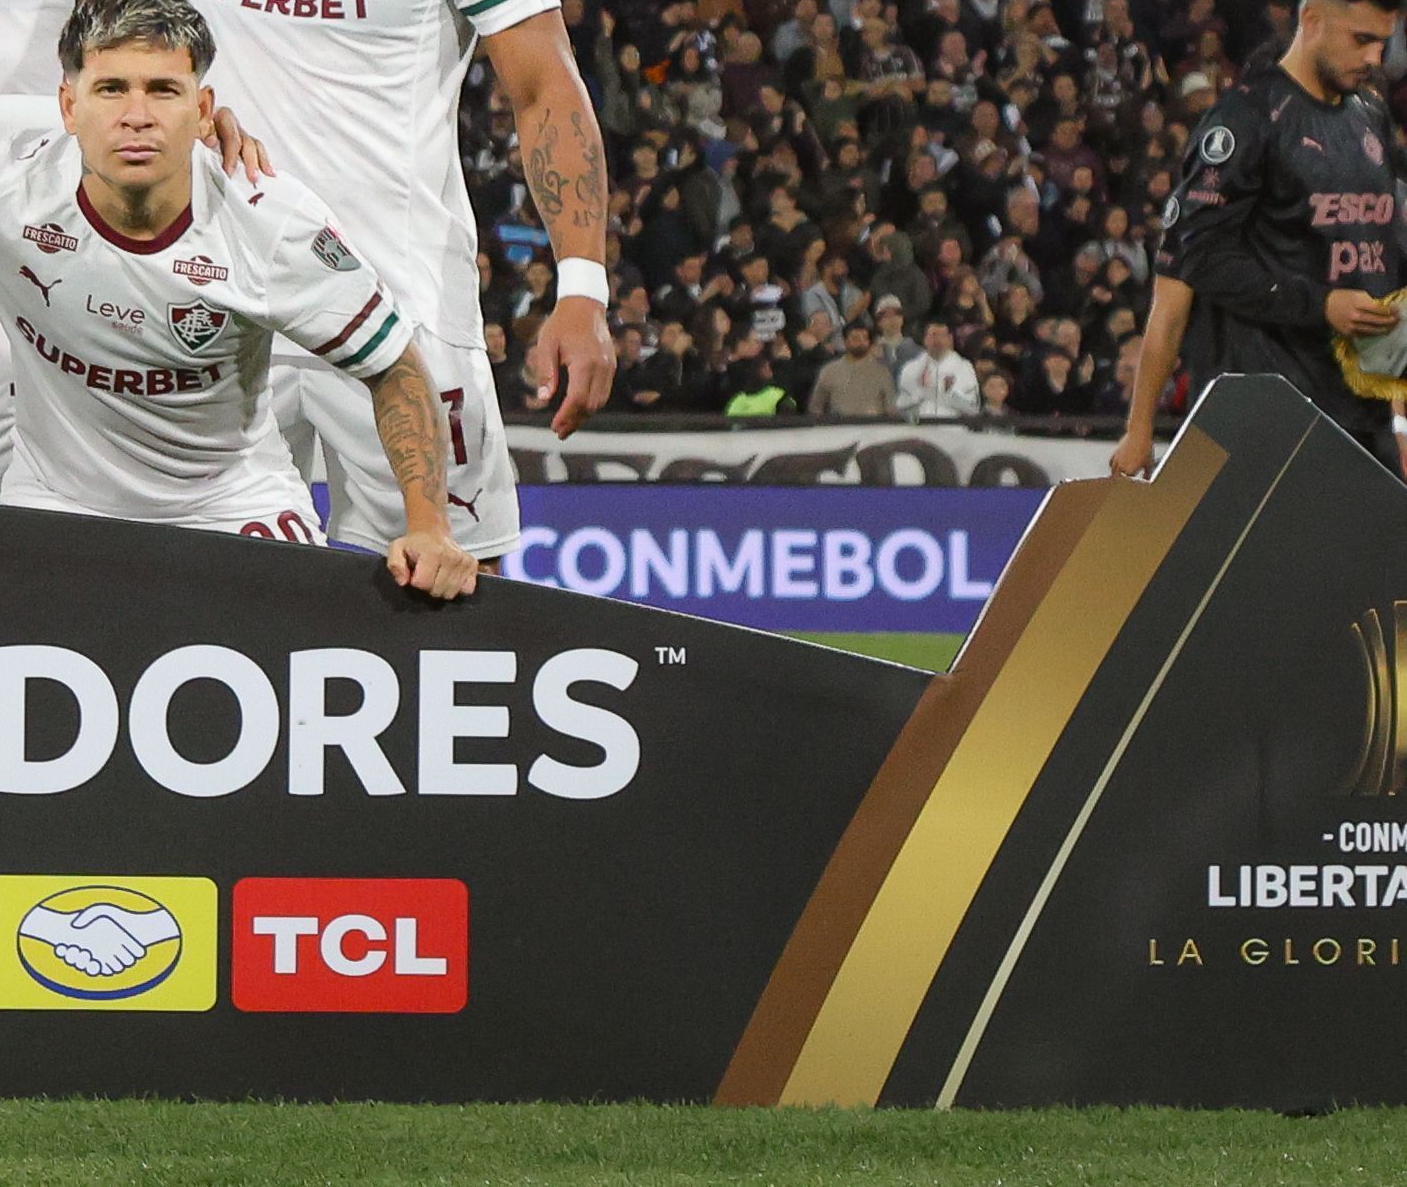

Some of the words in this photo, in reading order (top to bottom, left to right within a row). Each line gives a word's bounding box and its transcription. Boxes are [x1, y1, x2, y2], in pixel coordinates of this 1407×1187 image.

[23, 227, 78, 250] FRESCATTO
[173, 260, 228, 279] FRESCATTO
[1329, 240, 1386, 281] pax
[87, 294, 145, 325] Leve
[16, 316, 226, 396] SUPERBET
[502, 526, 995, 601] CONMEBOL
[253, 915, 447, 977] TCL
[1149, 938, 1203, 965] LA
[1240, 938, 1399, 965] GLORI
